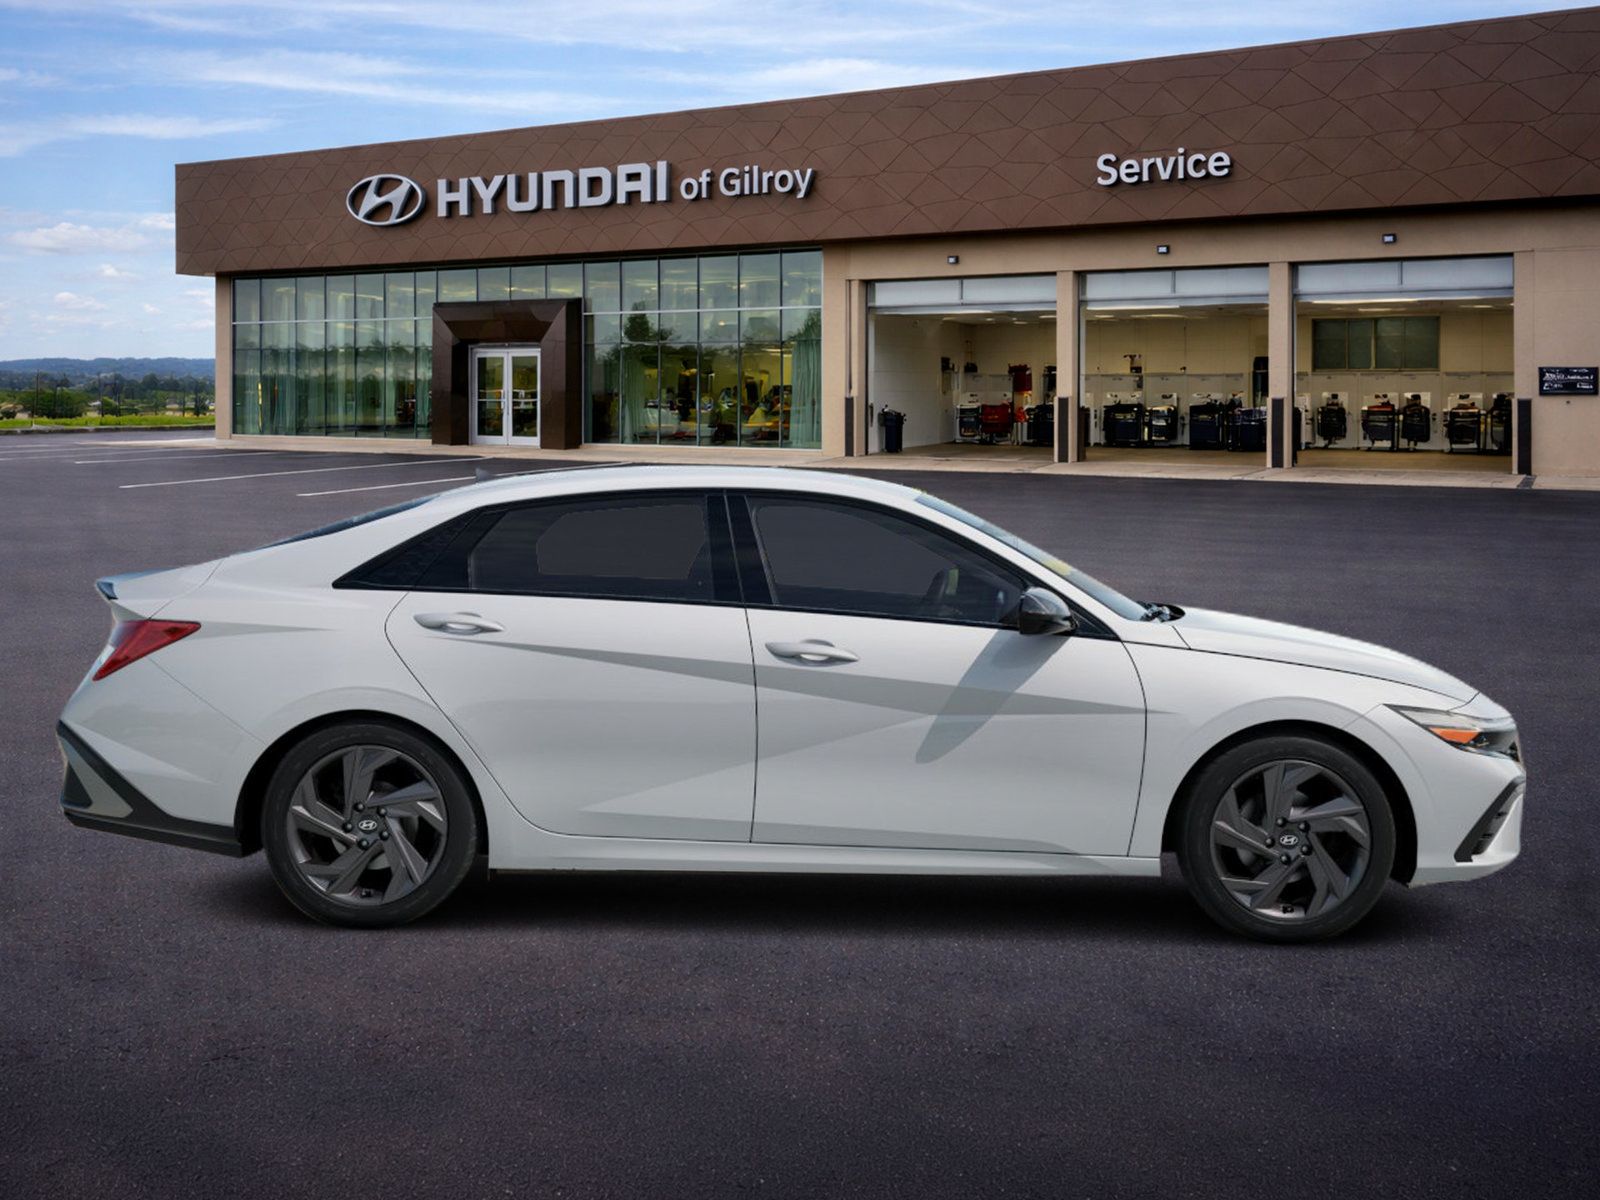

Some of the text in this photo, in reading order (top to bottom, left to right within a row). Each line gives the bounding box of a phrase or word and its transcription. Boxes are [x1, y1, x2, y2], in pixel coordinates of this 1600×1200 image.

[437, 160, 667, 217] HYUNDAI
[679, 168, 711, 200] of
[719, 164, 813, 199] Gilroy
[1096, 147, 1231, 186] Service
